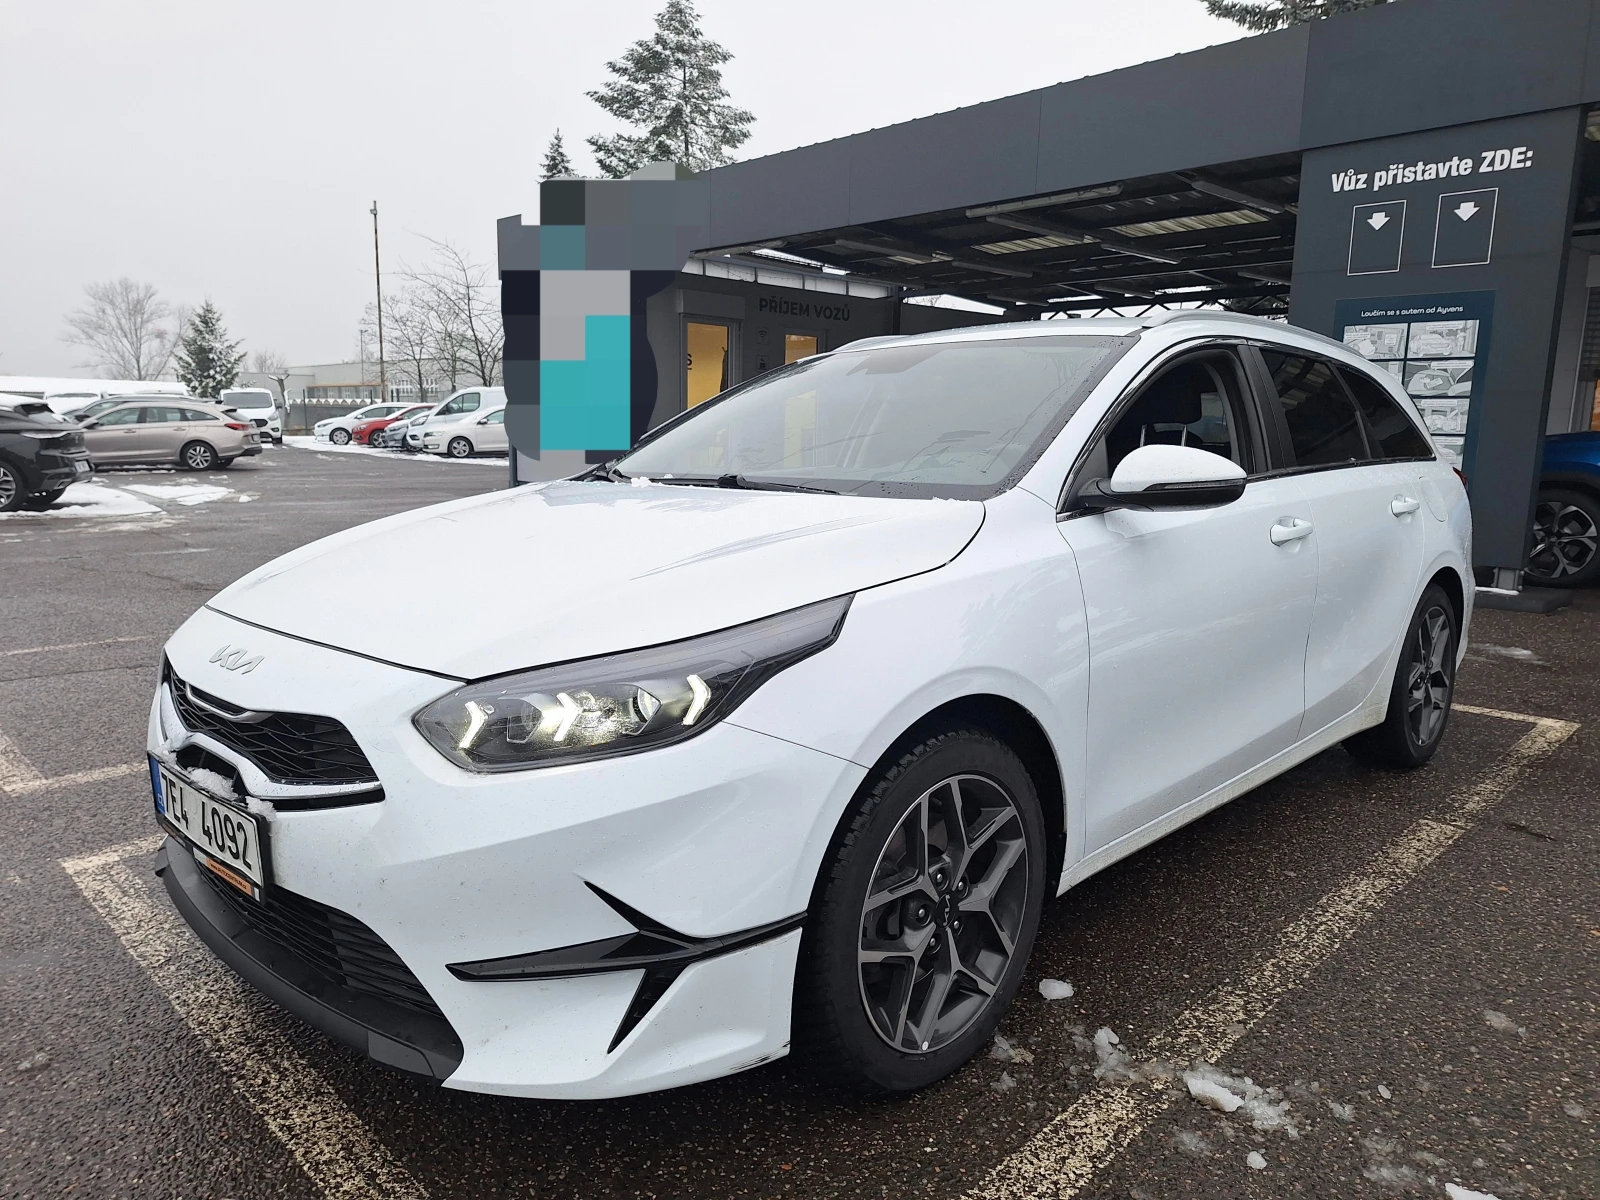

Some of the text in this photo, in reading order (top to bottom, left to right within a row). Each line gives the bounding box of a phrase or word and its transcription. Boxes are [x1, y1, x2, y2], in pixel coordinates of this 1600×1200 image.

[1331, 146, 1534, 193] Vůz přistavte ZDE:
[759, 295, 851, 322] PŘÍJEM VOZŮ
[1361, 309, 1386, 318] Loučím
[1400, 306, 1425, 316] autem
[1425, 305, 1436, 314] od
[1436, 305, 1464, 315] Ayvens
[201, 800, 253, 872] 4092
